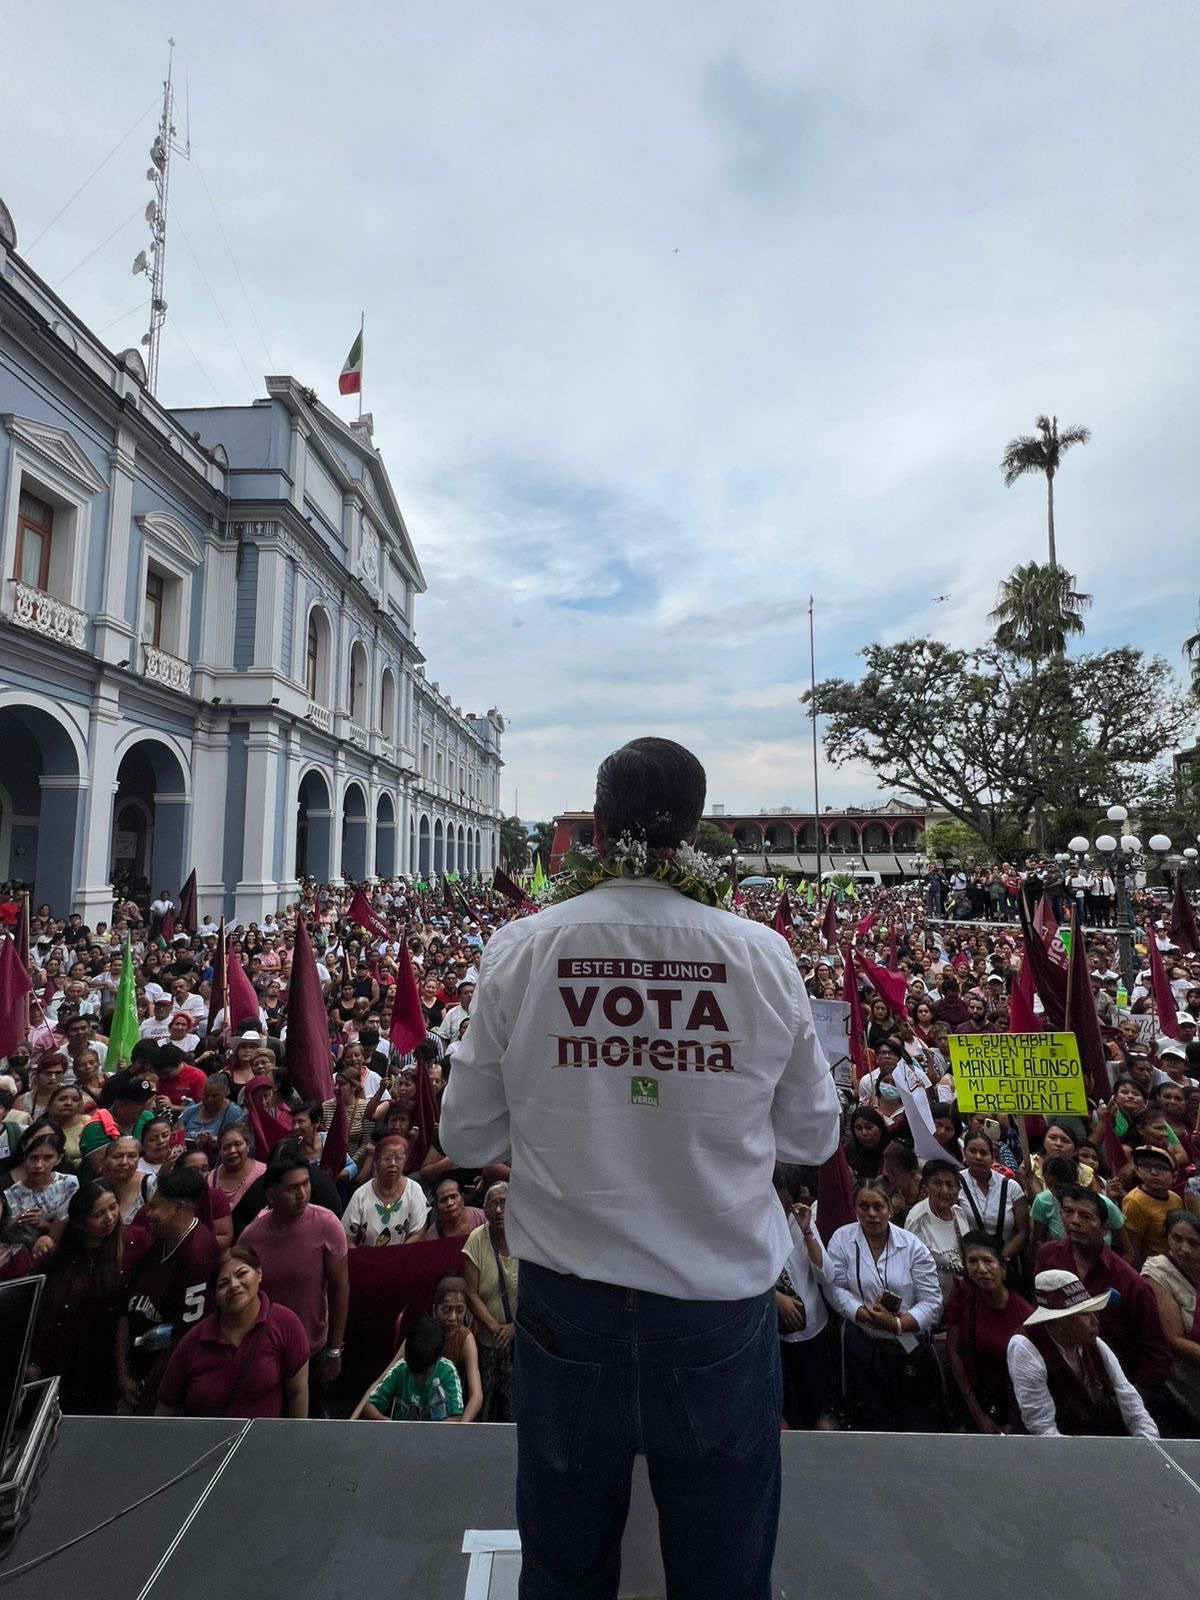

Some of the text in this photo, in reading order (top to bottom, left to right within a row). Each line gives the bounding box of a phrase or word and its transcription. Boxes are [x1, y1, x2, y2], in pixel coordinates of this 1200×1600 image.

[571, 962, 713, 979] ESTE 1 DE JUNIO
[559, 986, 729, 1032] VOTA
[957, 1033, 1063, 1047] EL GUAYABAL
[557, 1035, 735, 1073] morena
[967, 1047, 1037, 1058] PRESENTE
[959, 1058, 1080, 1077] MANUEL ALONSO
[968, 1079, 1058, 1093] MI FUTURO
[632, 1095, 658, 1106] VERDE
[973, 1092, 1077, 1111] PRESIDENTE
[183, 1282, 207, 1323] 5
